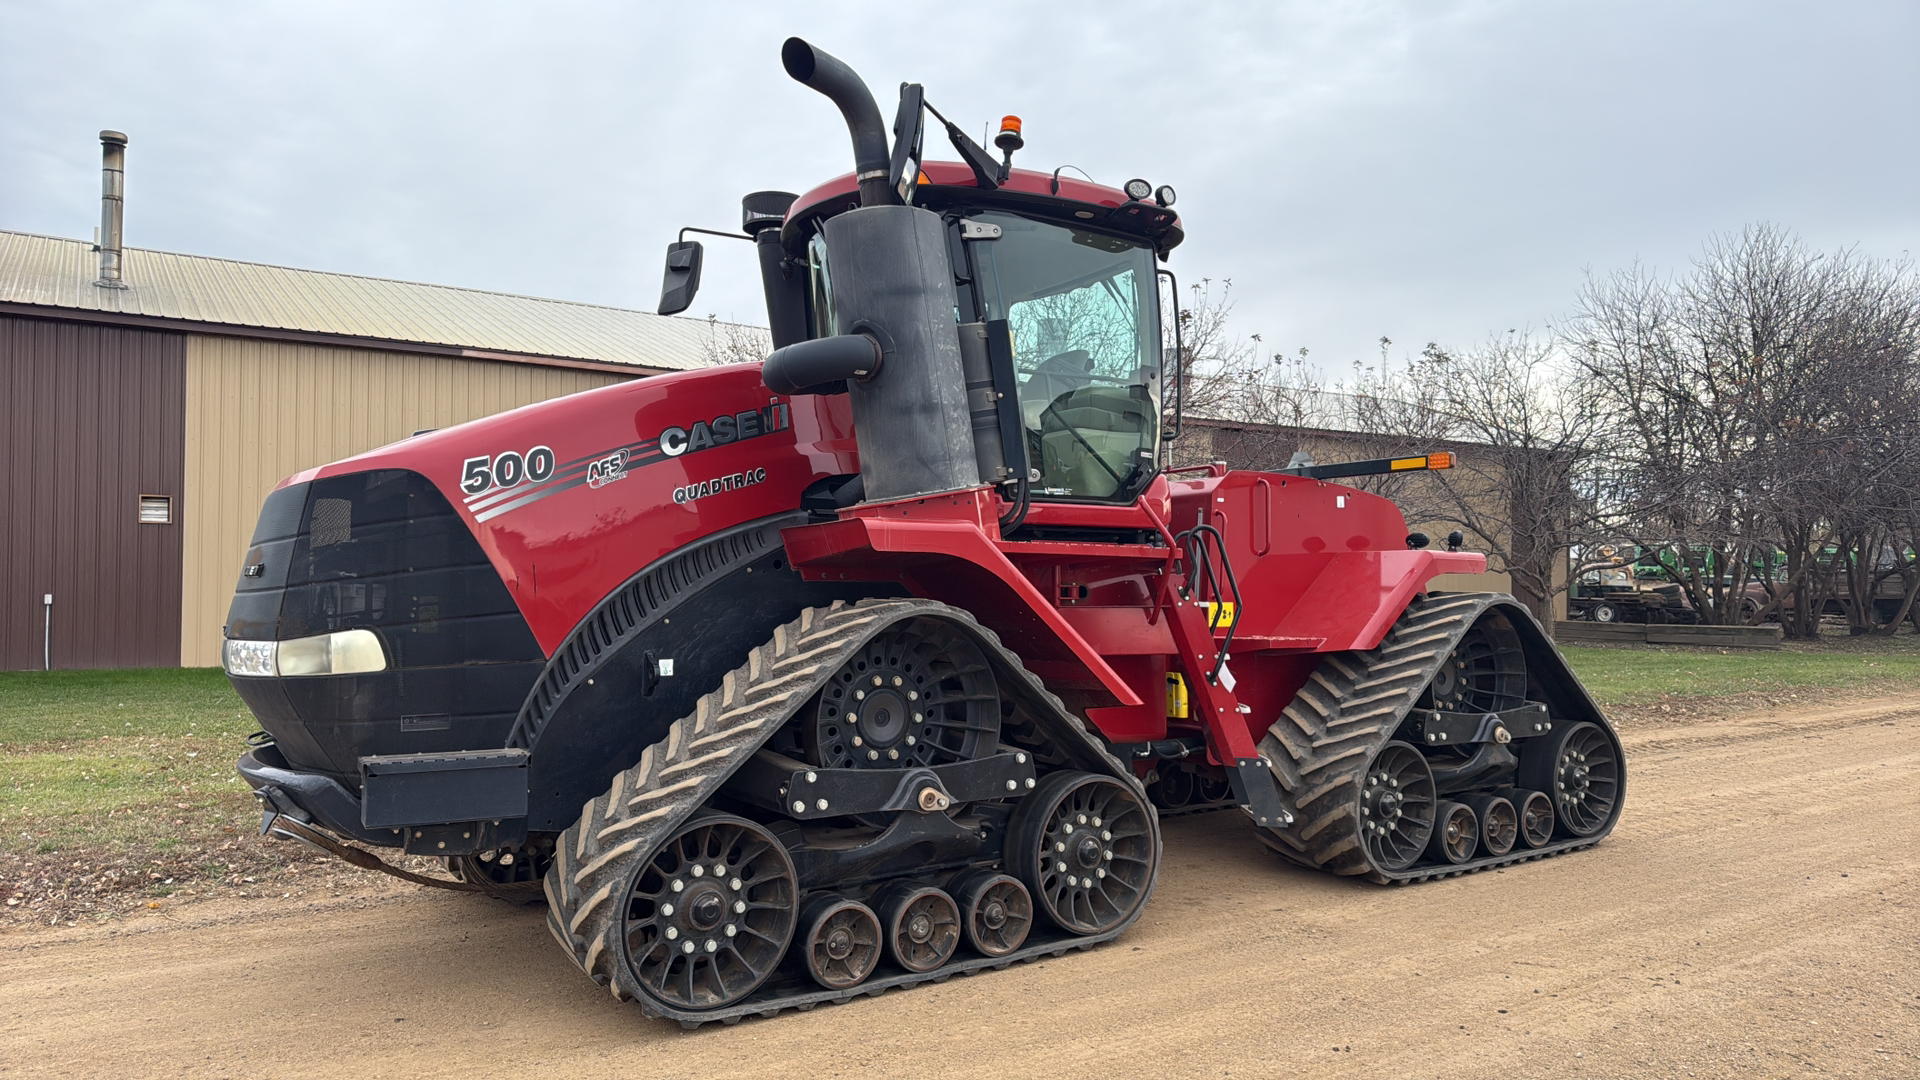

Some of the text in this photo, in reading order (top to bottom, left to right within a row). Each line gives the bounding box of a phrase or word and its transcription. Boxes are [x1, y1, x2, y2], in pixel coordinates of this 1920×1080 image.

[460, 445, 555, 495] 500
[587, 454, 622, 482] AFS
[673, 467, 766, 504] QUADTRAC
